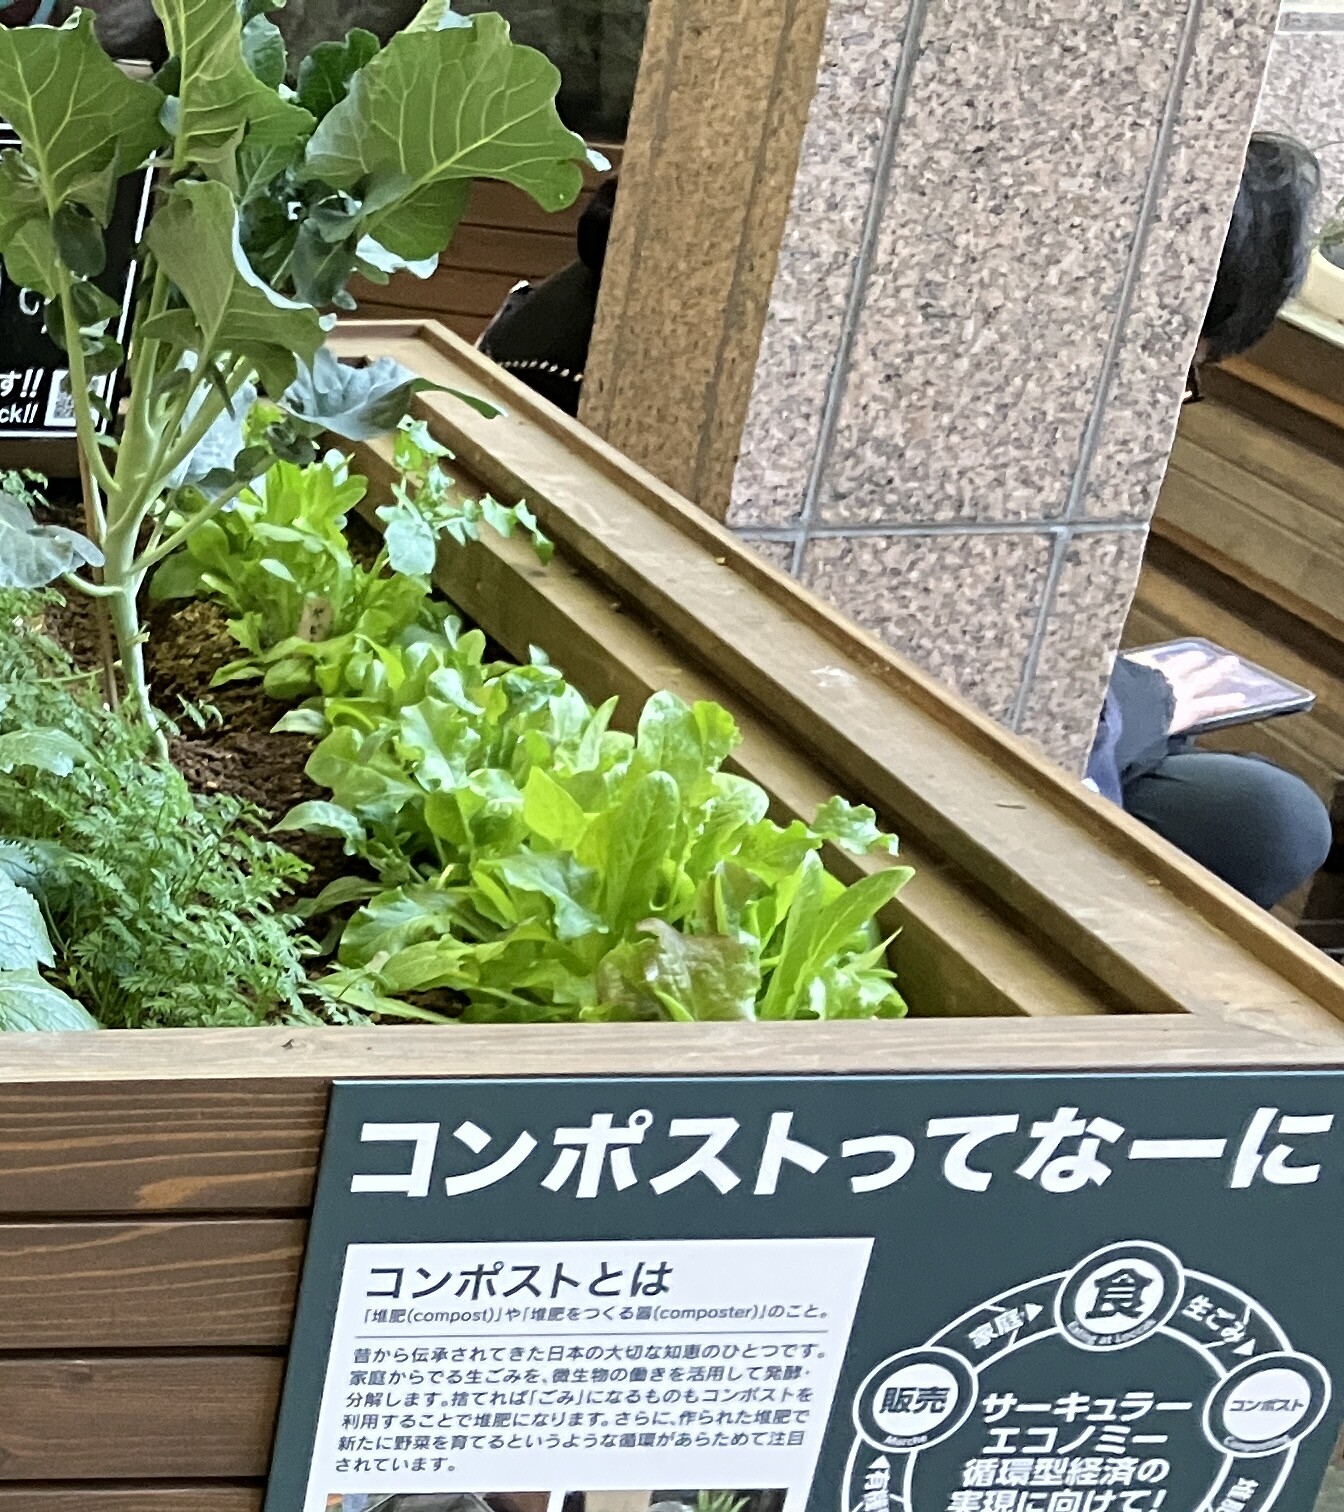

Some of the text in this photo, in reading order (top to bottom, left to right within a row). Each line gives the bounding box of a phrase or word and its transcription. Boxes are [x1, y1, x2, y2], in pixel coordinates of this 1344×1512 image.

[350, 1107, 1334, 1198] コンポストってなーに
[367, 1261, 673, 1300] コンポストとは
[1082, 1266, 1155, 1321] 食
[1181, 1293, 1248, 1344] 生ごみ
[878, 1384, 952, 1416] 販売
[982, 1392, 1192, 1423] サーキュラー
[1228, 1397, 1305, 1415] コンポスト
[982, 1425, 1168, 1454] エコノミー
[336, 1457, 455, 1472] されています。
[962, 1457, 1169, 1487] 循環型経済の
